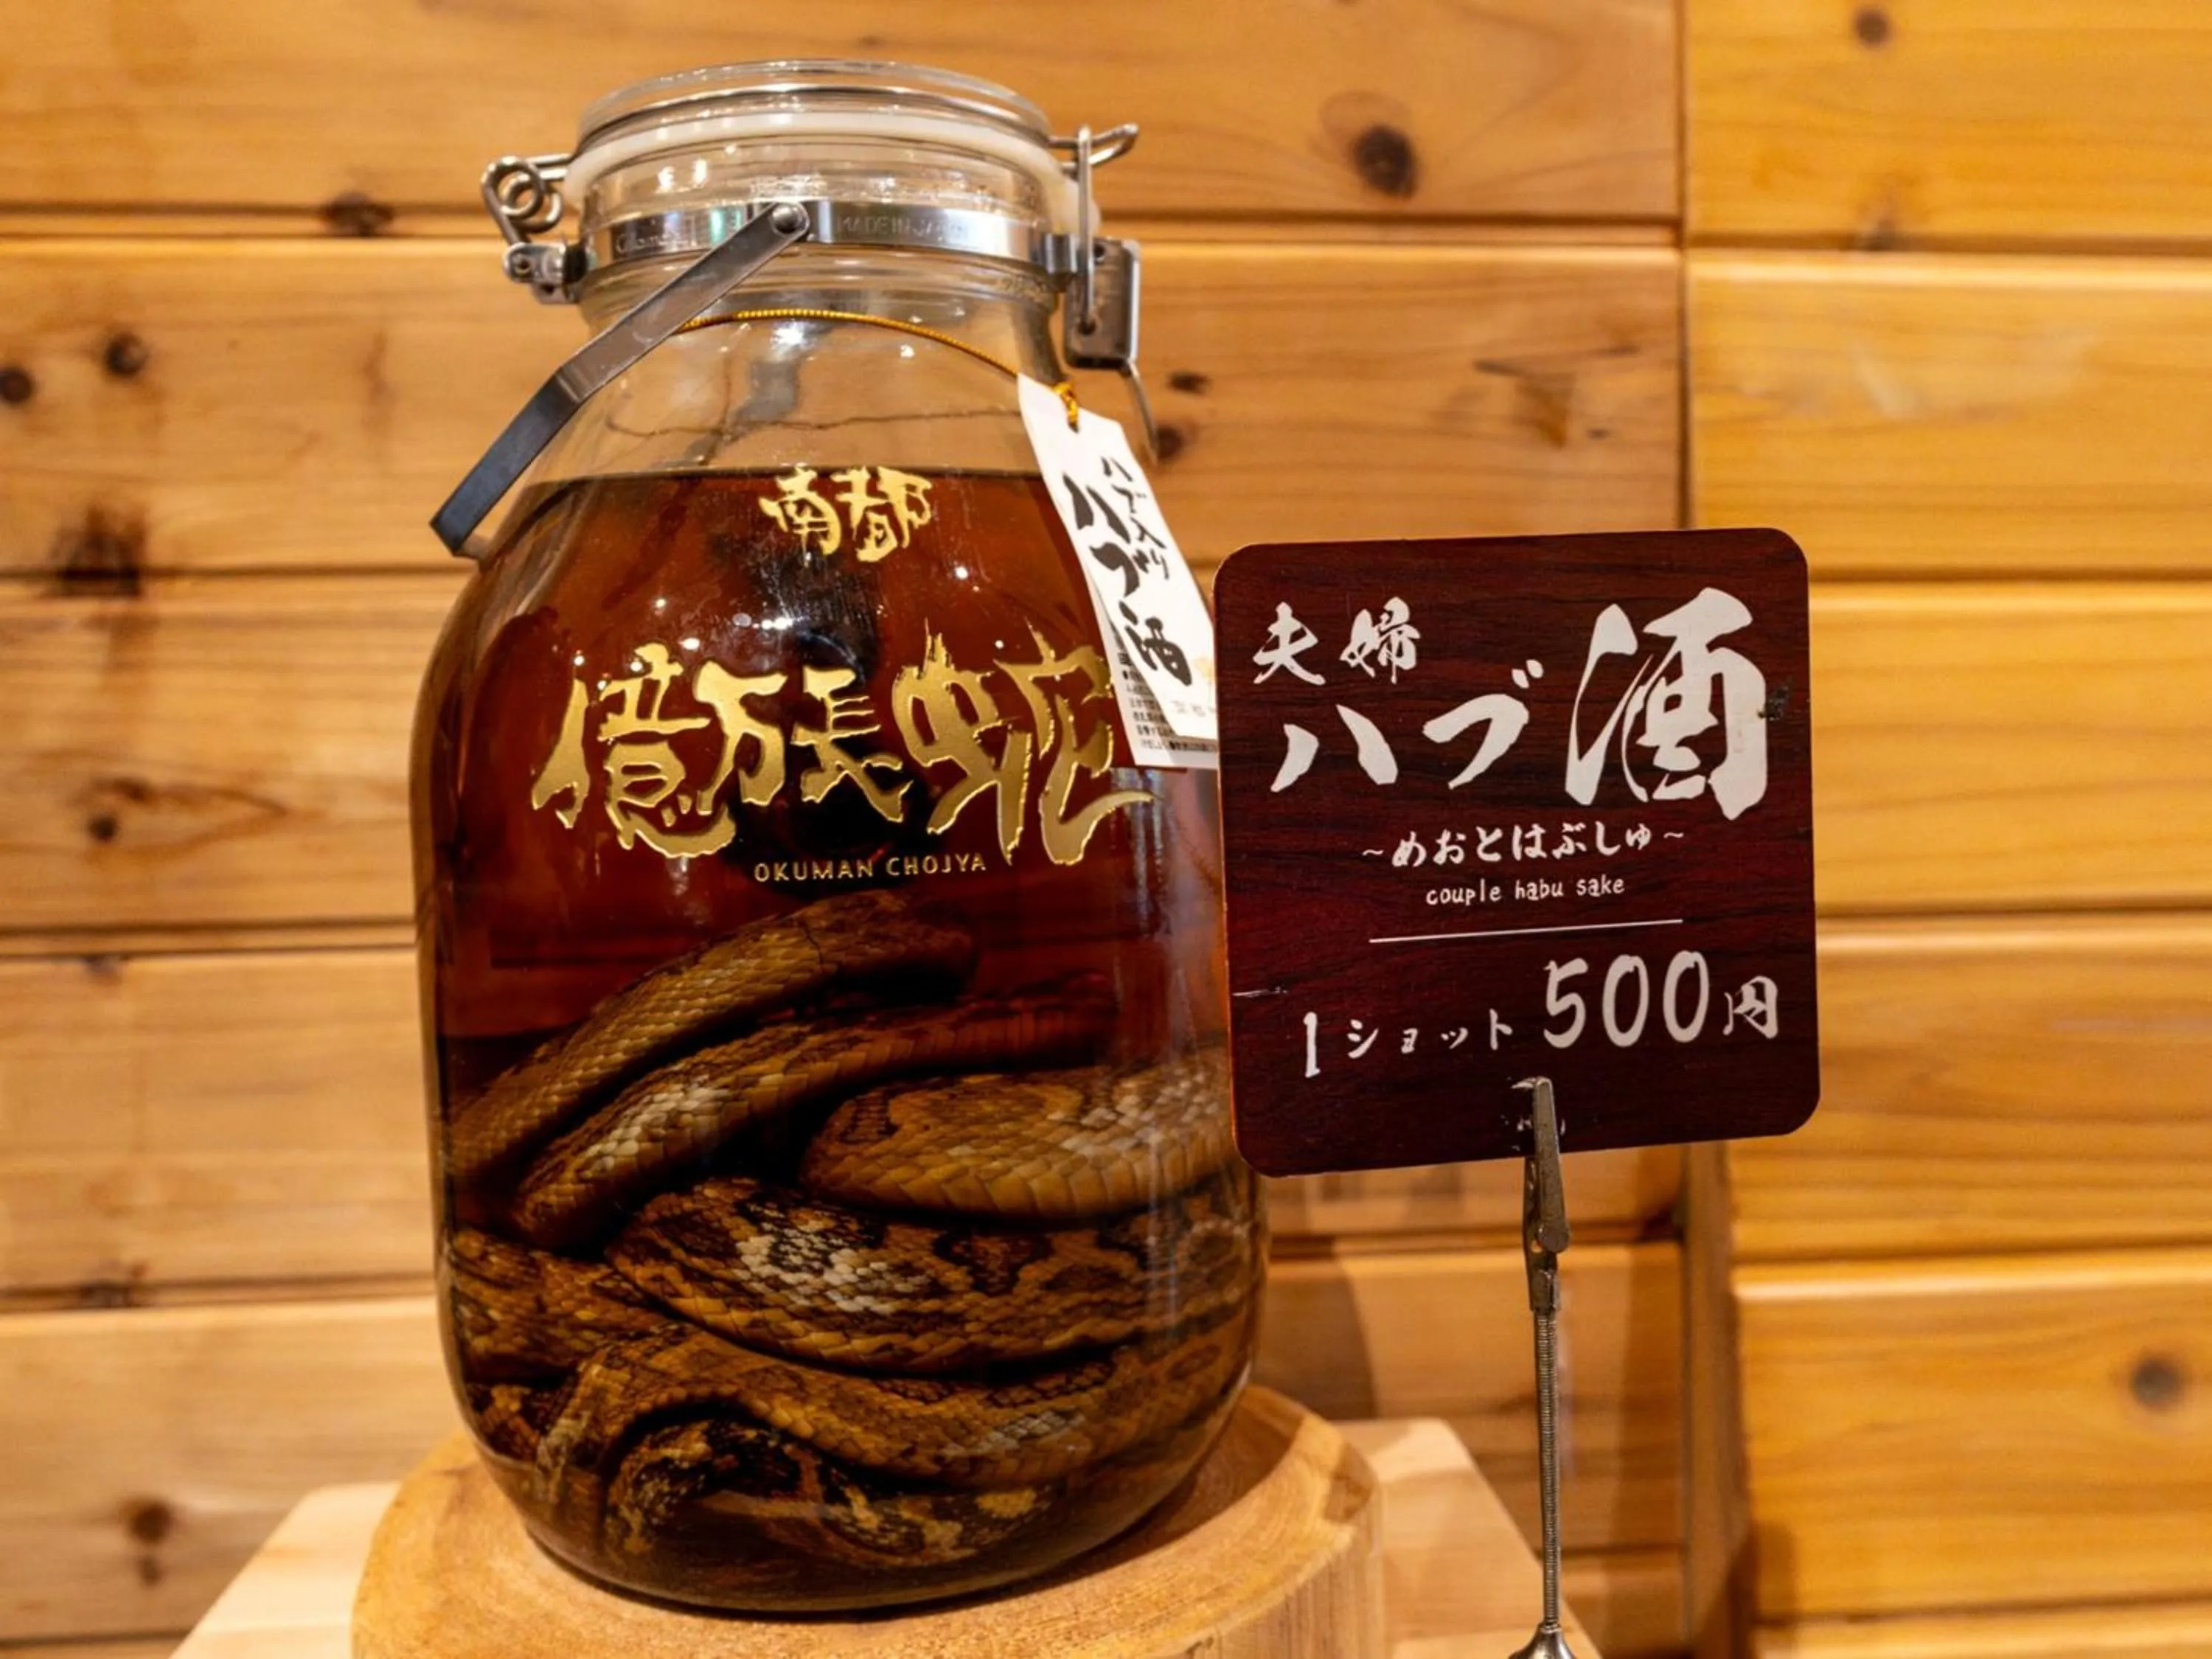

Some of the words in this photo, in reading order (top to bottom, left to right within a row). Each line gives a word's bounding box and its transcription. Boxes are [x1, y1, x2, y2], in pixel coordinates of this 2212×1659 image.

[760, 466, 933, 563] 南都
[1062, 471, 1194, 688] ハブ酒
[1253, 597, 1422, 686] 夫婦
[1270, 587, 1769, 821] ハブ酒
[754, 858, 874, 883] OKUMAN
[886, 852, 987, 876] CHOJYA
[1425, 878, 1503, 906] couple
[1514, 877, 1564, 902] habu
[1576, 874, 1625, 897] sake
